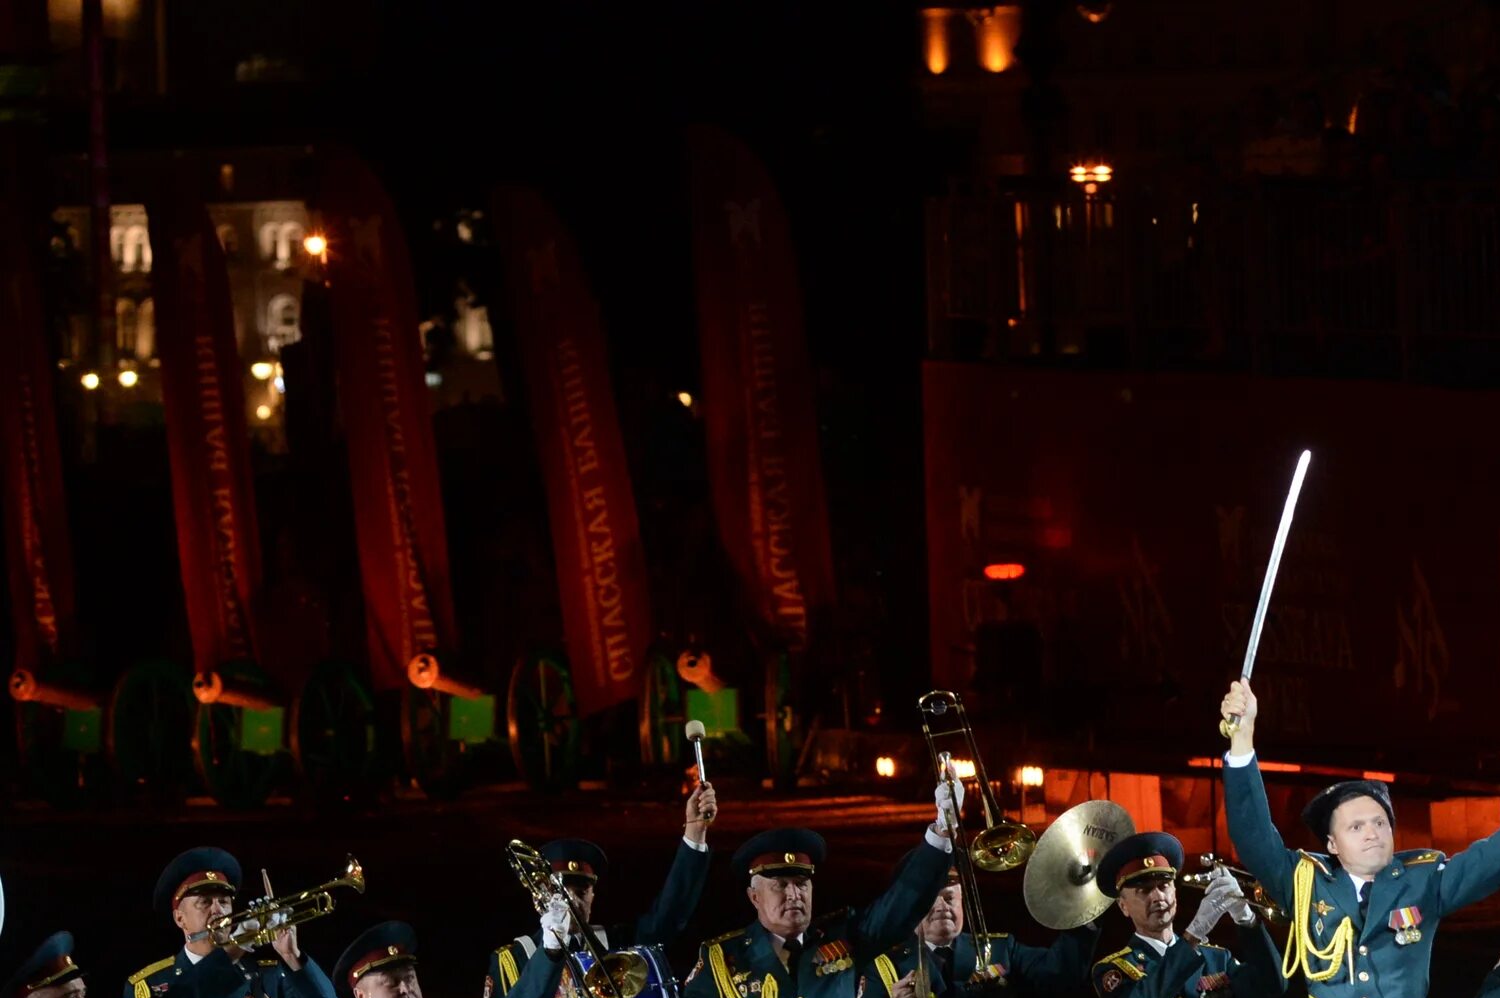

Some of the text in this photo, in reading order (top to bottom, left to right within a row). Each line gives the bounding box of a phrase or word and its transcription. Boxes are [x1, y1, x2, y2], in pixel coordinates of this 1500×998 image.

[556, 336, 634, 682] СПАССКАЯ БАШНЯ
[1083, 824, 1117, 841] SABIAN
